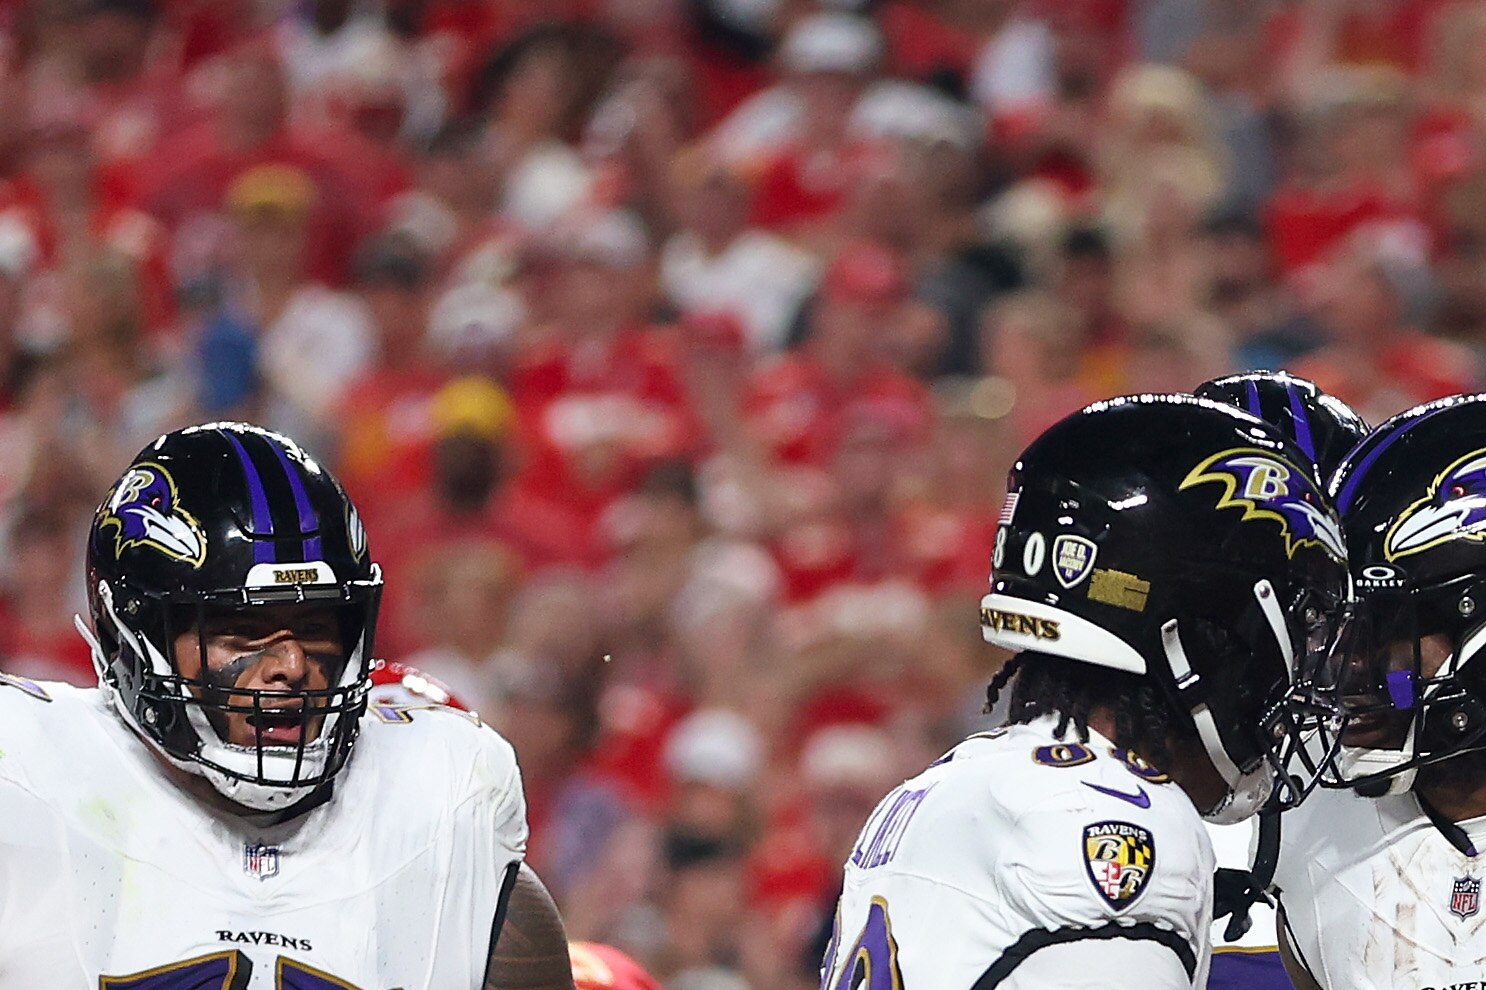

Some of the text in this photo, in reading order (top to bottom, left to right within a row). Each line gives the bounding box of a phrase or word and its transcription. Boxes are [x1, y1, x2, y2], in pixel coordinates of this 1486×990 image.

[273, 568, 318, 583] RAVENS
[1356, 579, 1404, 587] OAKLEY
[1087, 824, 1147, 842] RAVENS
[1452, 893, 1476, 912] NFL
[216, 930, 313, 951] RAVENS
